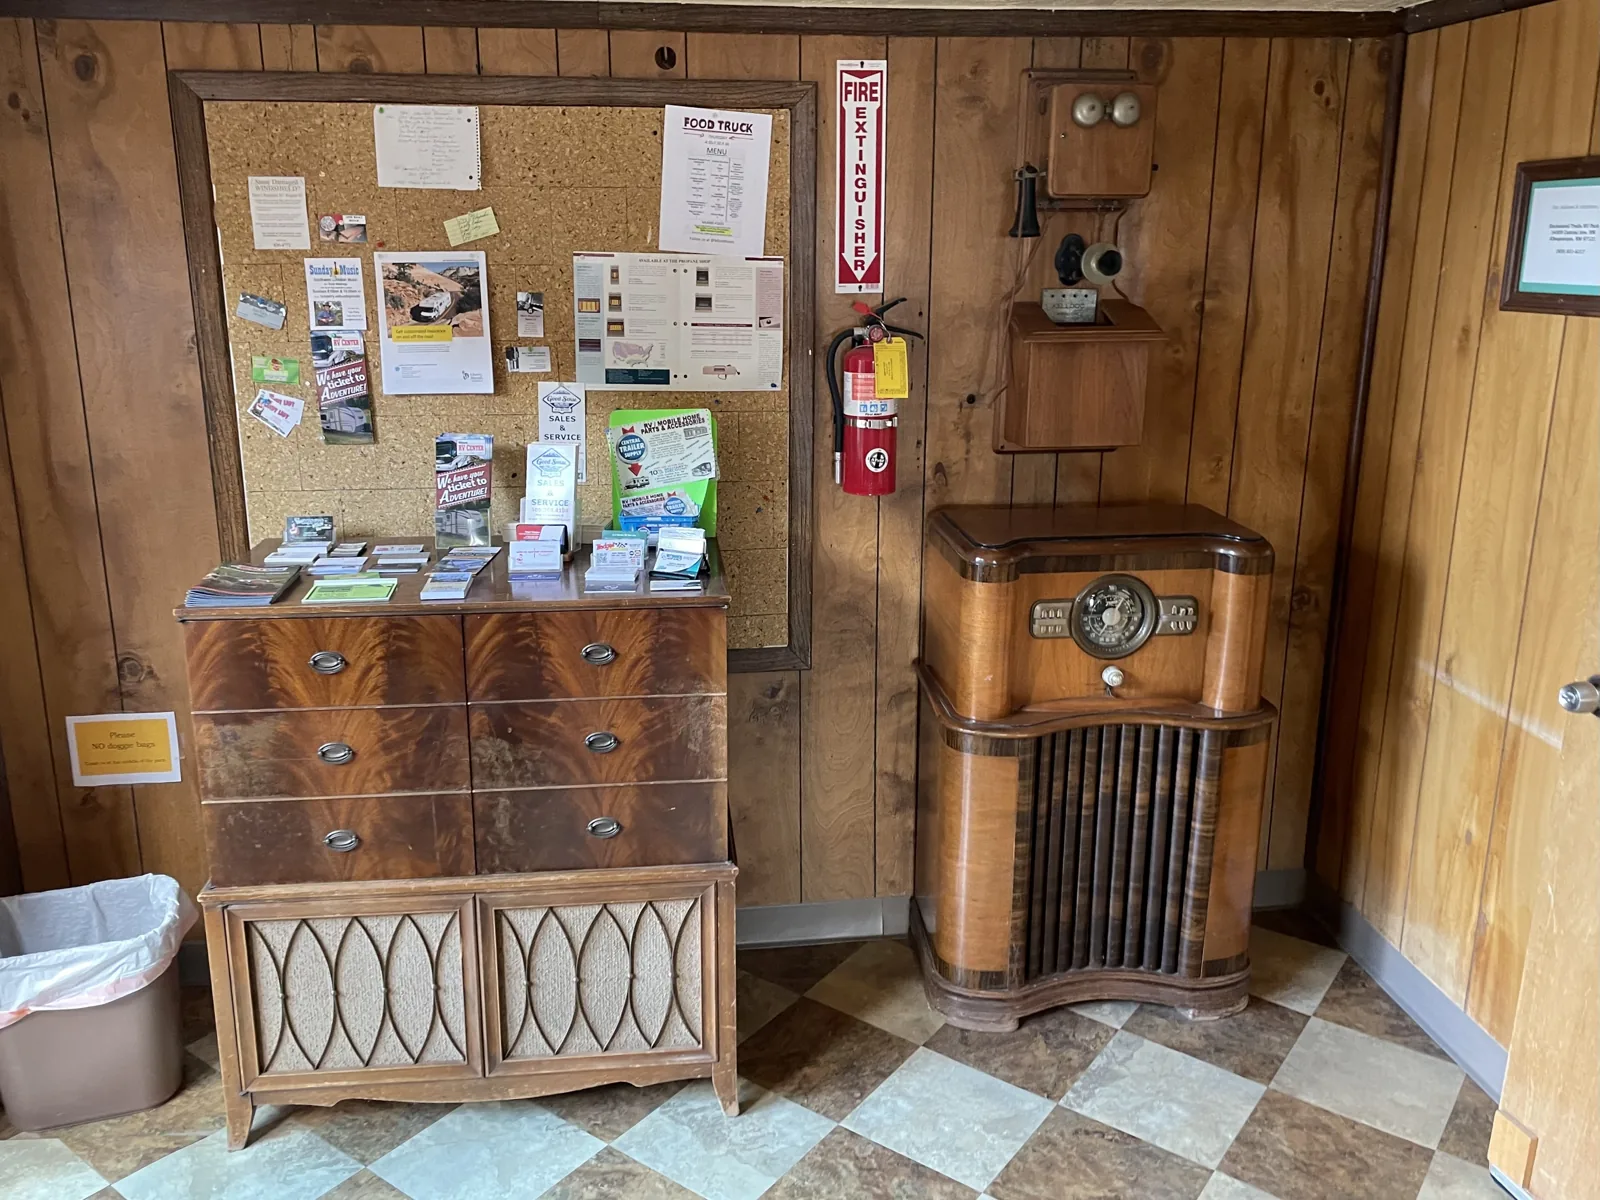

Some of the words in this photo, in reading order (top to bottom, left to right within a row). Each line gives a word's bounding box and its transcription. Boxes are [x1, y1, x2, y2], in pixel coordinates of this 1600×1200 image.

[844, 81, 879, 102] FIRE
[684, 117, 715, 130] FOOD
[717, 120, 753, 133] TRUCK
[706, 147, 728, 155] MENU
[853, 106, 868, 271] EXTINGUISHER
[309, 264, 333, 277] Sunday
[339, 264, 360, 275] Music
[316, 370, 330, 386] We
[331, 371, 346, 380] have
[347, 366, 362, 378] your
[327, 376, 355, 389] ticket
[356, 374, 366, 383] to
[321, 383, 367, 402] ADVENTURE!
[640, 426, 660, 434] PARTS
[667, 417, 706, 430] ACCESSORIES
[657, 417, 680, 426] MOBILE
[619, 442, 645, 453] TRAILER
[621, 438, 641, 446] CENTRAL
[624, 450, 642, 458] SUPPLY
[436, 474, 452, 490] We
[453, 474, 468, 483] have
[470, 470, 484, 482] your
[448, 479, 476, 492] ticket
[476, 478, 487, 486] to
[440, 486, 488, 504] ADVENTURE!
[109, 731, 136, 739] Please
[92, 742, 106, 750] NO
